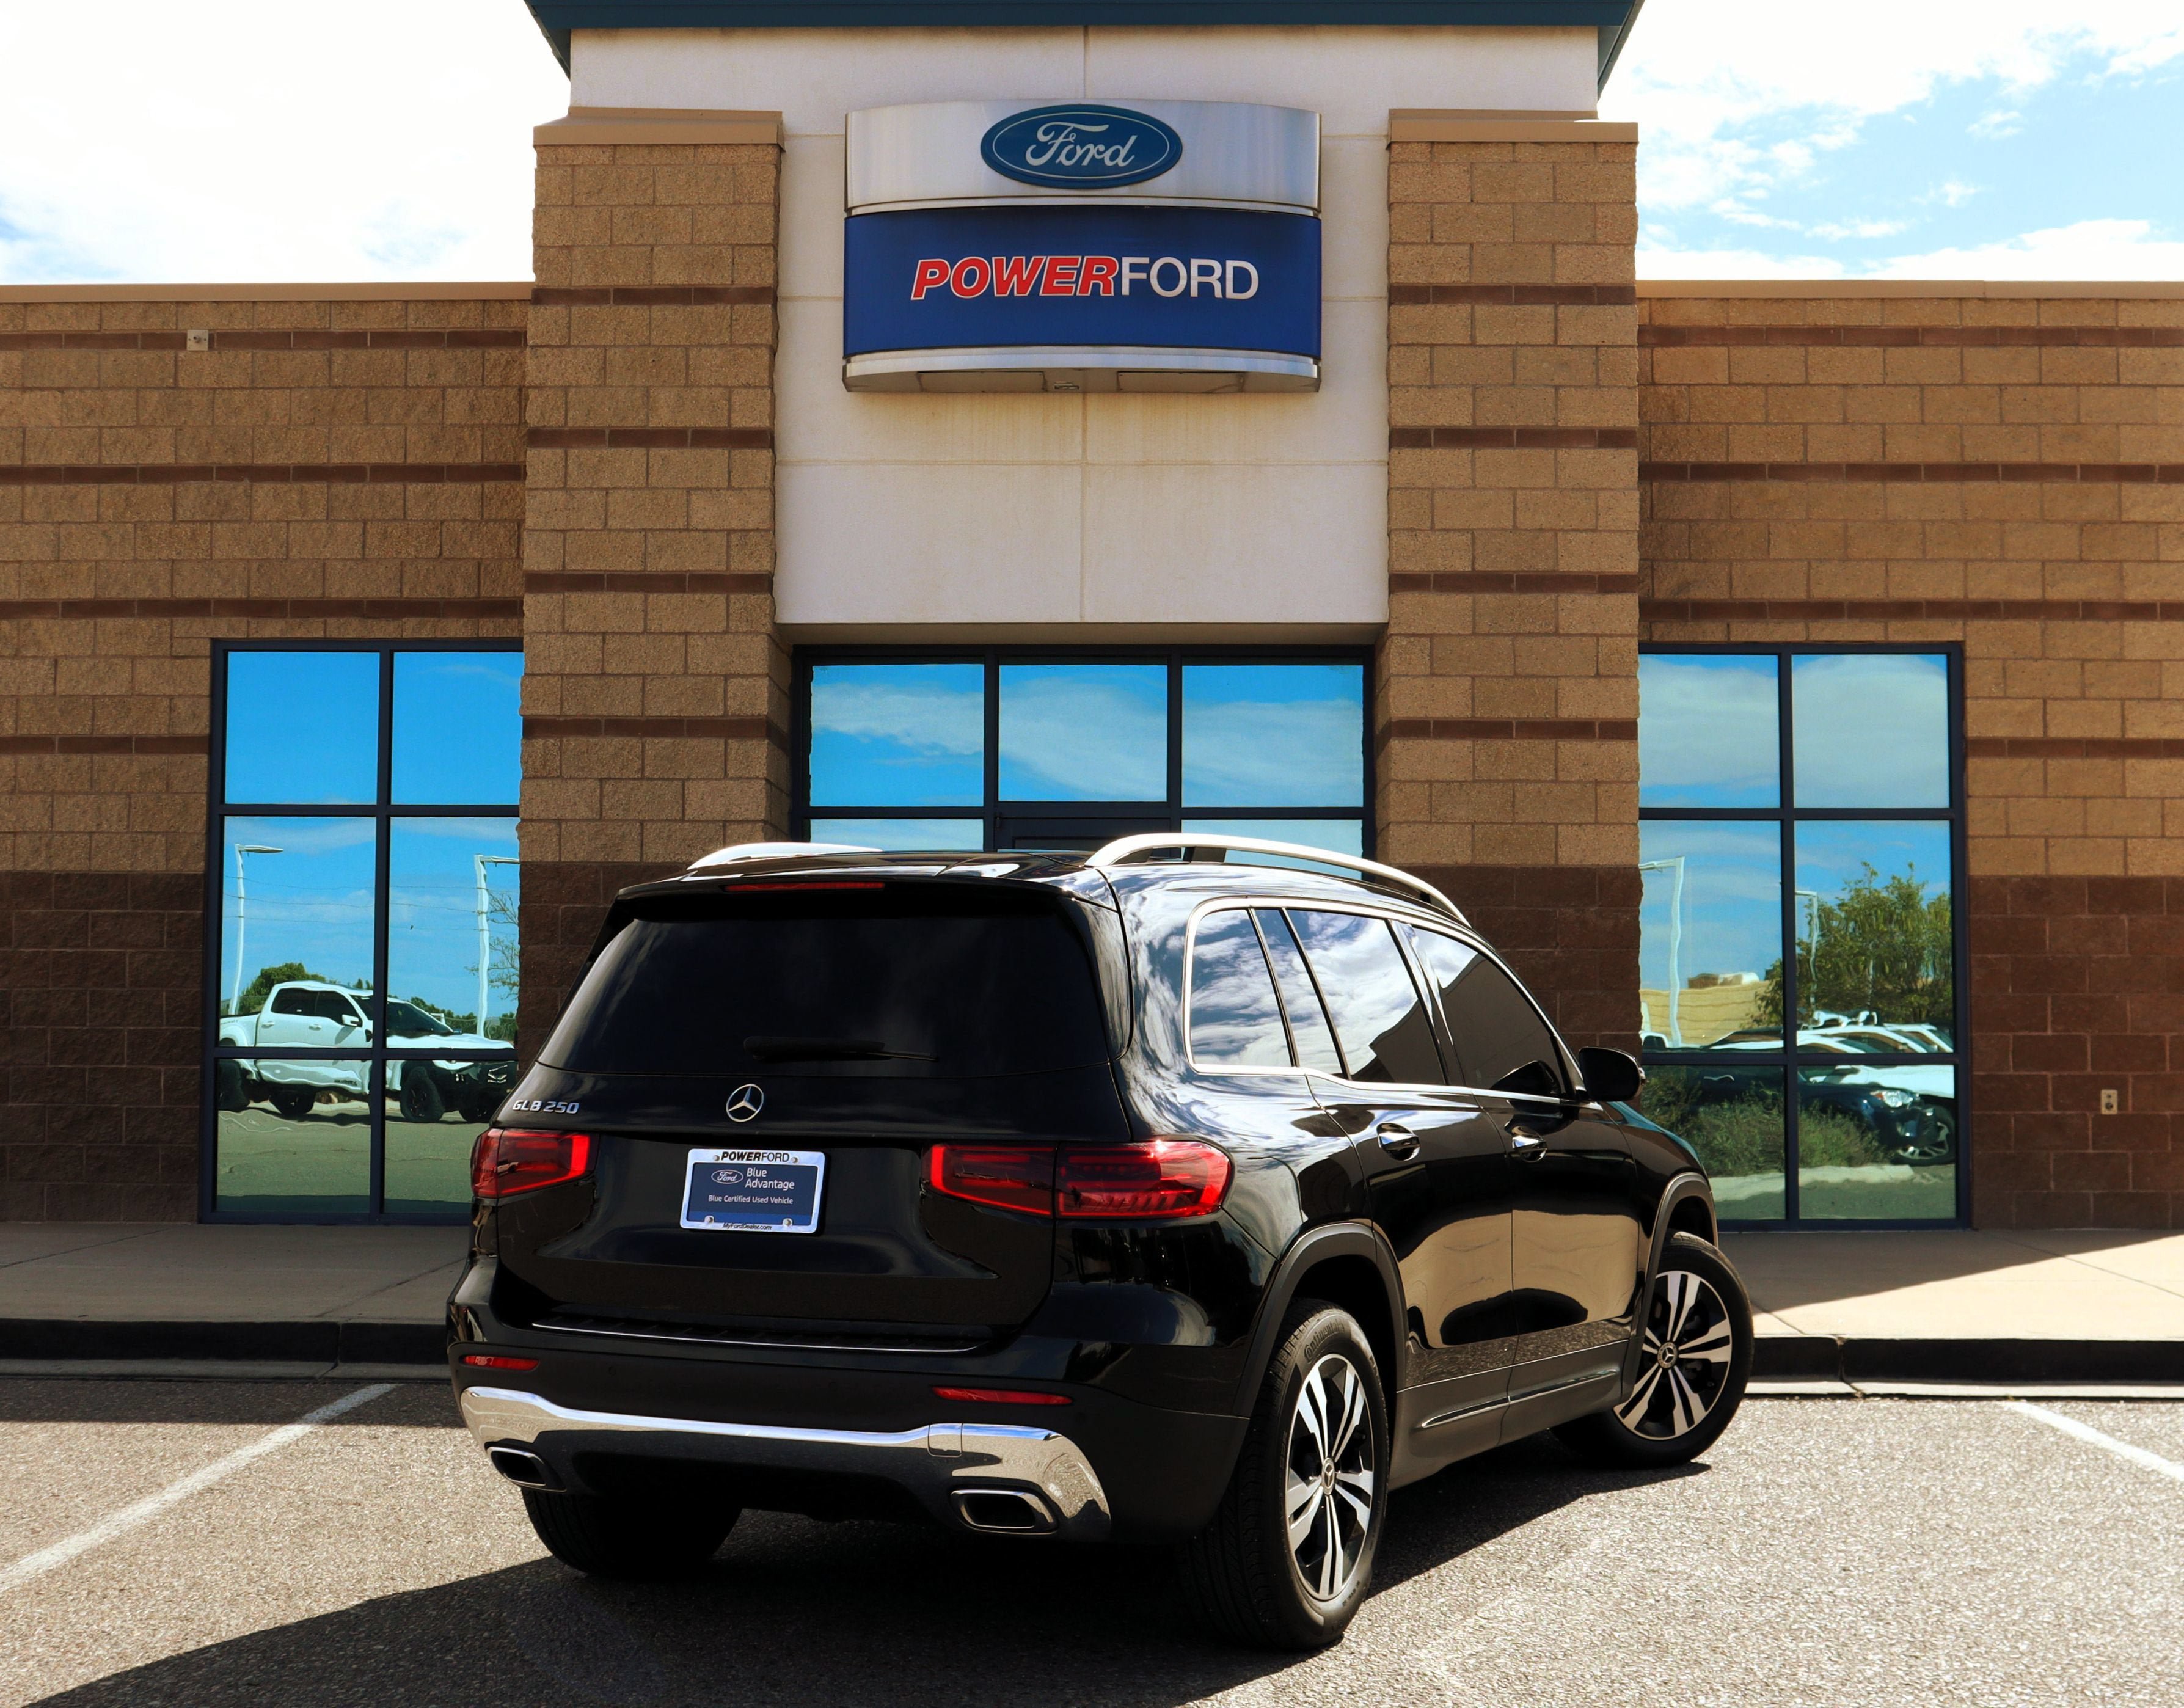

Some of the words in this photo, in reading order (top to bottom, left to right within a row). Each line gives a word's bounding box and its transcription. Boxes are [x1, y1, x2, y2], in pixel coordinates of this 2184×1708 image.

[1025, 121, 1138, 168] Ford
[910, 255, 1259, 301] POWERFORD
[512, 1100, 542, 1112] GLB
[543, 1101, 580, 1114] 250
[721, 1151, 790, 1162] POWERFORD
[717, 1170, 738, 1182] Ford
[746, 1167, 767, 1178] Blue
[745, 1178, 795, 1191] Advantage
[723, 1195, 751, 1203] Certified
